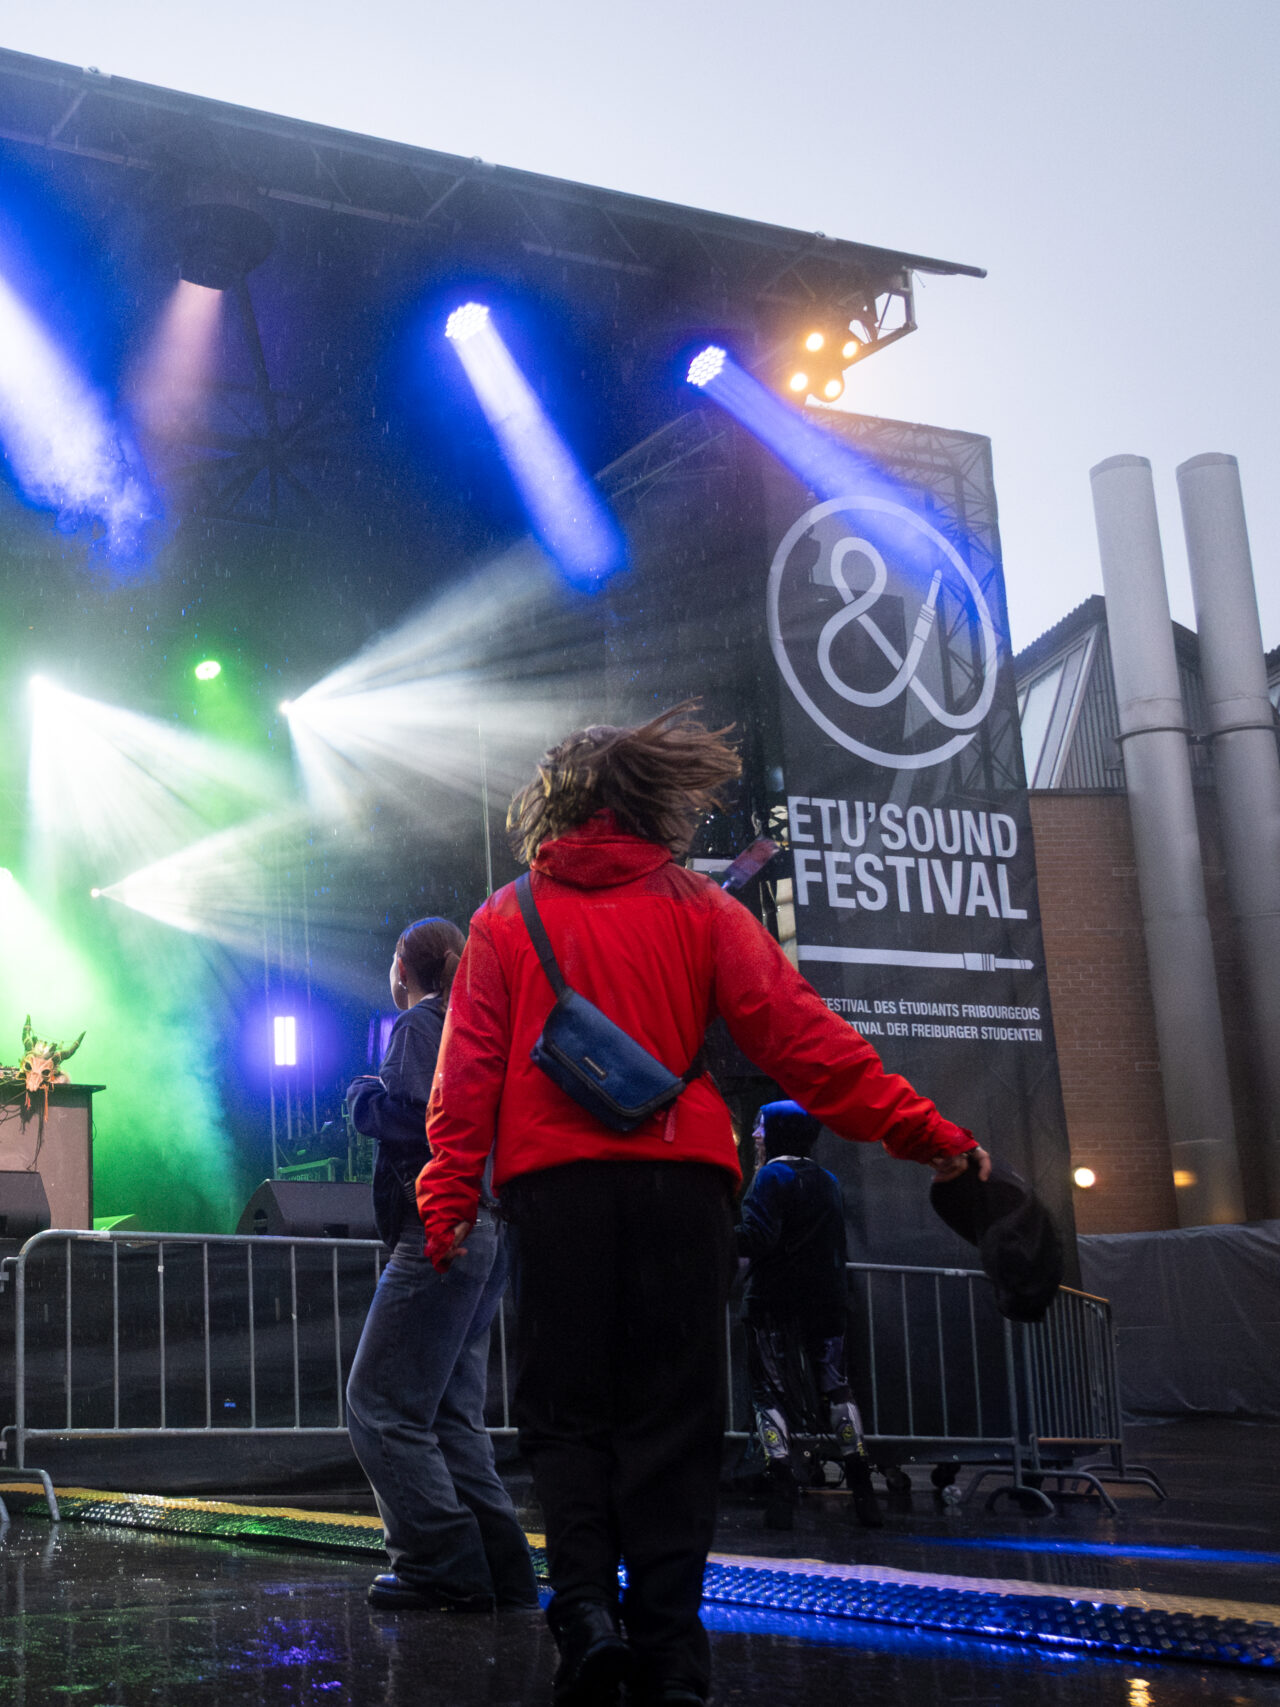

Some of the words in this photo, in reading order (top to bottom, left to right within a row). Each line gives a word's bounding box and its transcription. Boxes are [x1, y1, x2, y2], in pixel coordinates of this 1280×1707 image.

[793, 848, 1028, 920] FESTIVAL
[874, 1001, 897, 1014] DES
[899, 998, 960, 1017] ÉTUDIANTS
[962, 1004, 1040, 1020] FRIBOURGEOIS
[887, 1022, 909, 1036] DER
[912, 1024, 979, 1039] FREIBURGER
[981, 1027, 1042, 1042] STUDENTEN
